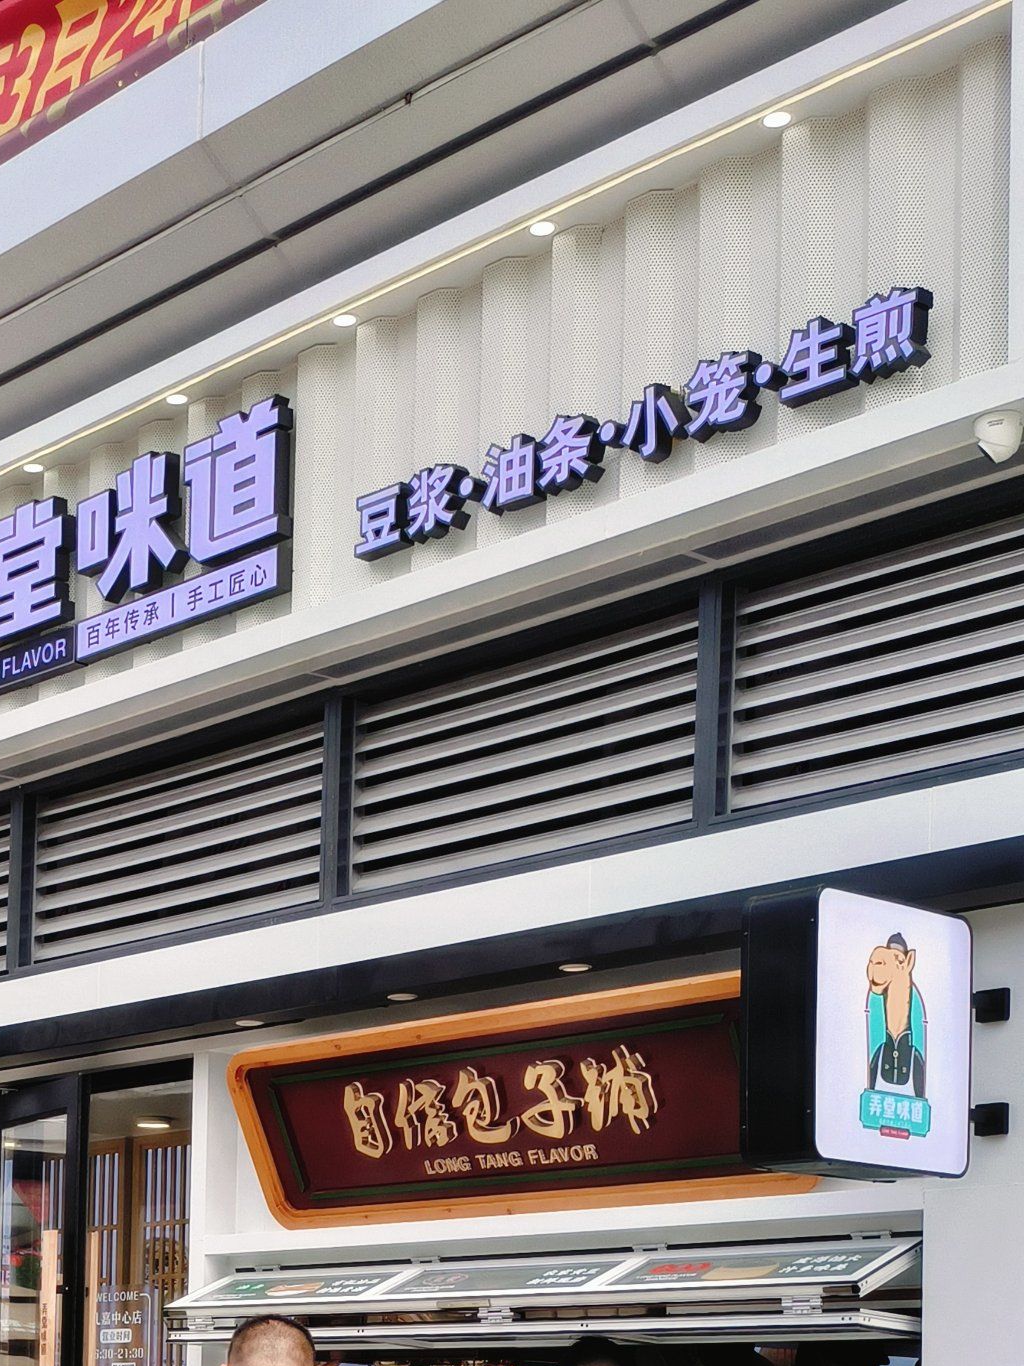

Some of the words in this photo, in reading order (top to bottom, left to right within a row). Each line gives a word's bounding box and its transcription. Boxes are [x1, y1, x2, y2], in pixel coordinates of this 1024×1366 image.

[86, 602, 160, 648] 百年传承
[187, 565, 268, 612] 手工匠心
[2, 637, 67, 682] FLAVOR
[424, 1156, 472, 1175] LONG
[475, 1150, 524, 1170] TANG
[528, 1143, 600, 1165] FLAVOR
[96, 1291, 139, 1303] WELCOME
